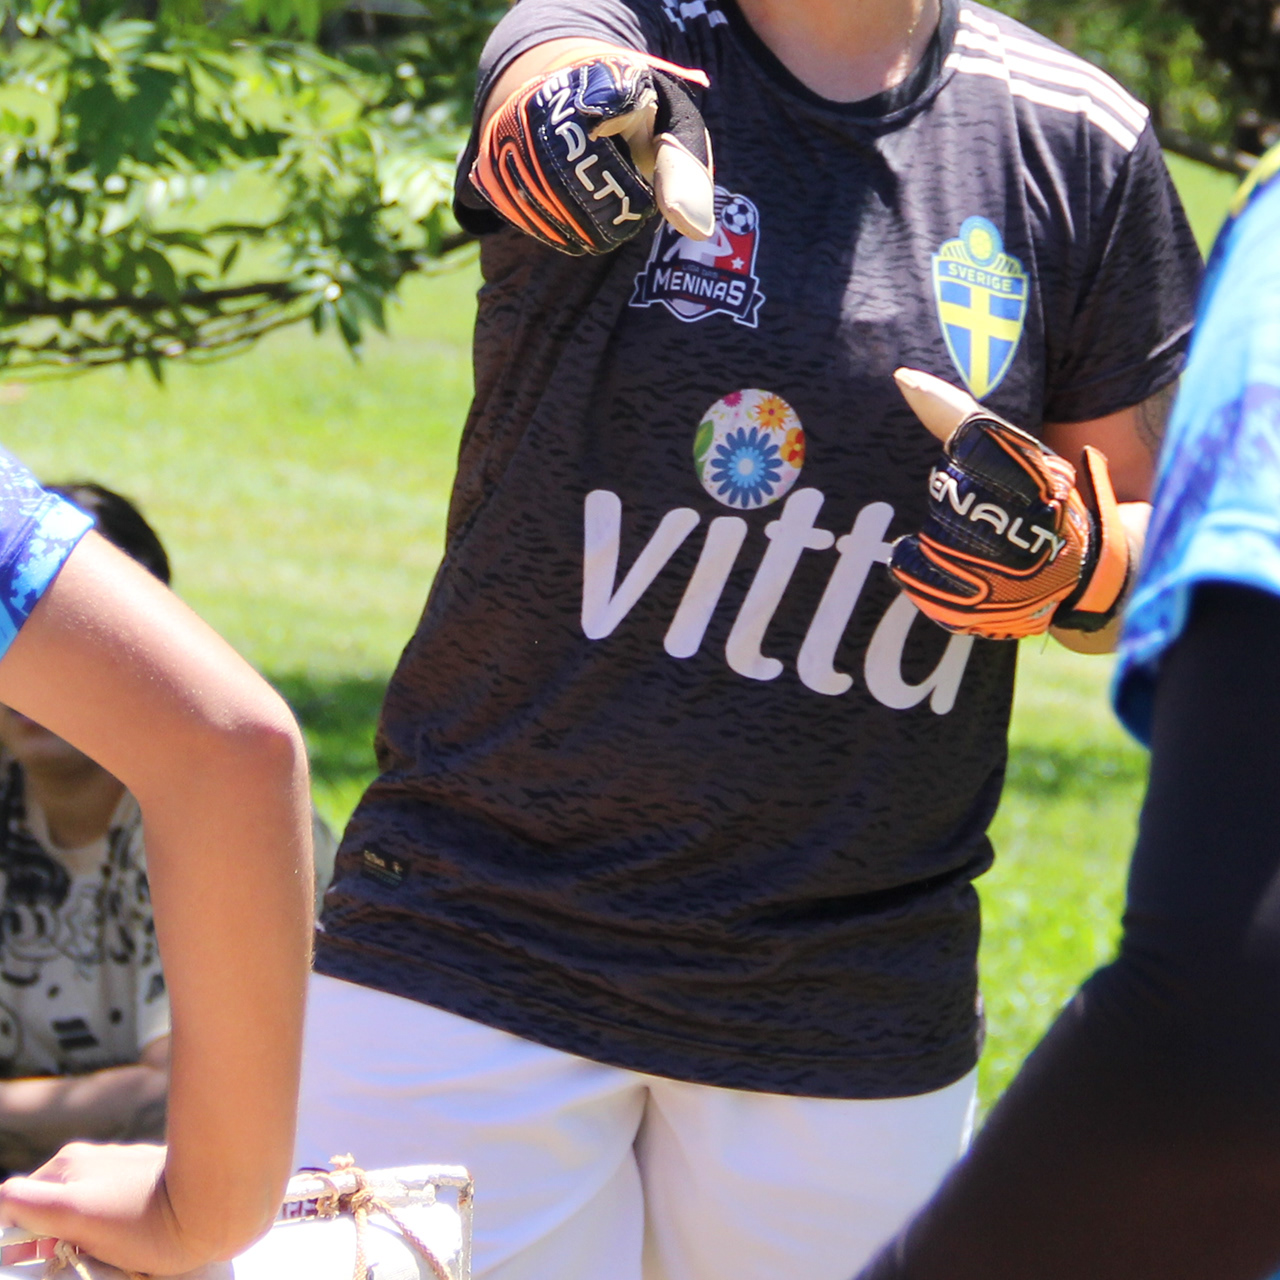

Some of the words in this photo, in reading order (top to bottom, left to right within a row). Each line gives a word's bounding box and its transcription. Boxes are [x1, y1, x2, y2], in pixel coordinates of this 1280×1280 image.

[540, 67, 642, 226] ENALTY
[652, 267, 747, 306] MENINAS
[947, 262, 1013, 293] SVERIGE
[928, 466, 1066, 562] ENALTY
[581, 487, 976, 716] vitta
